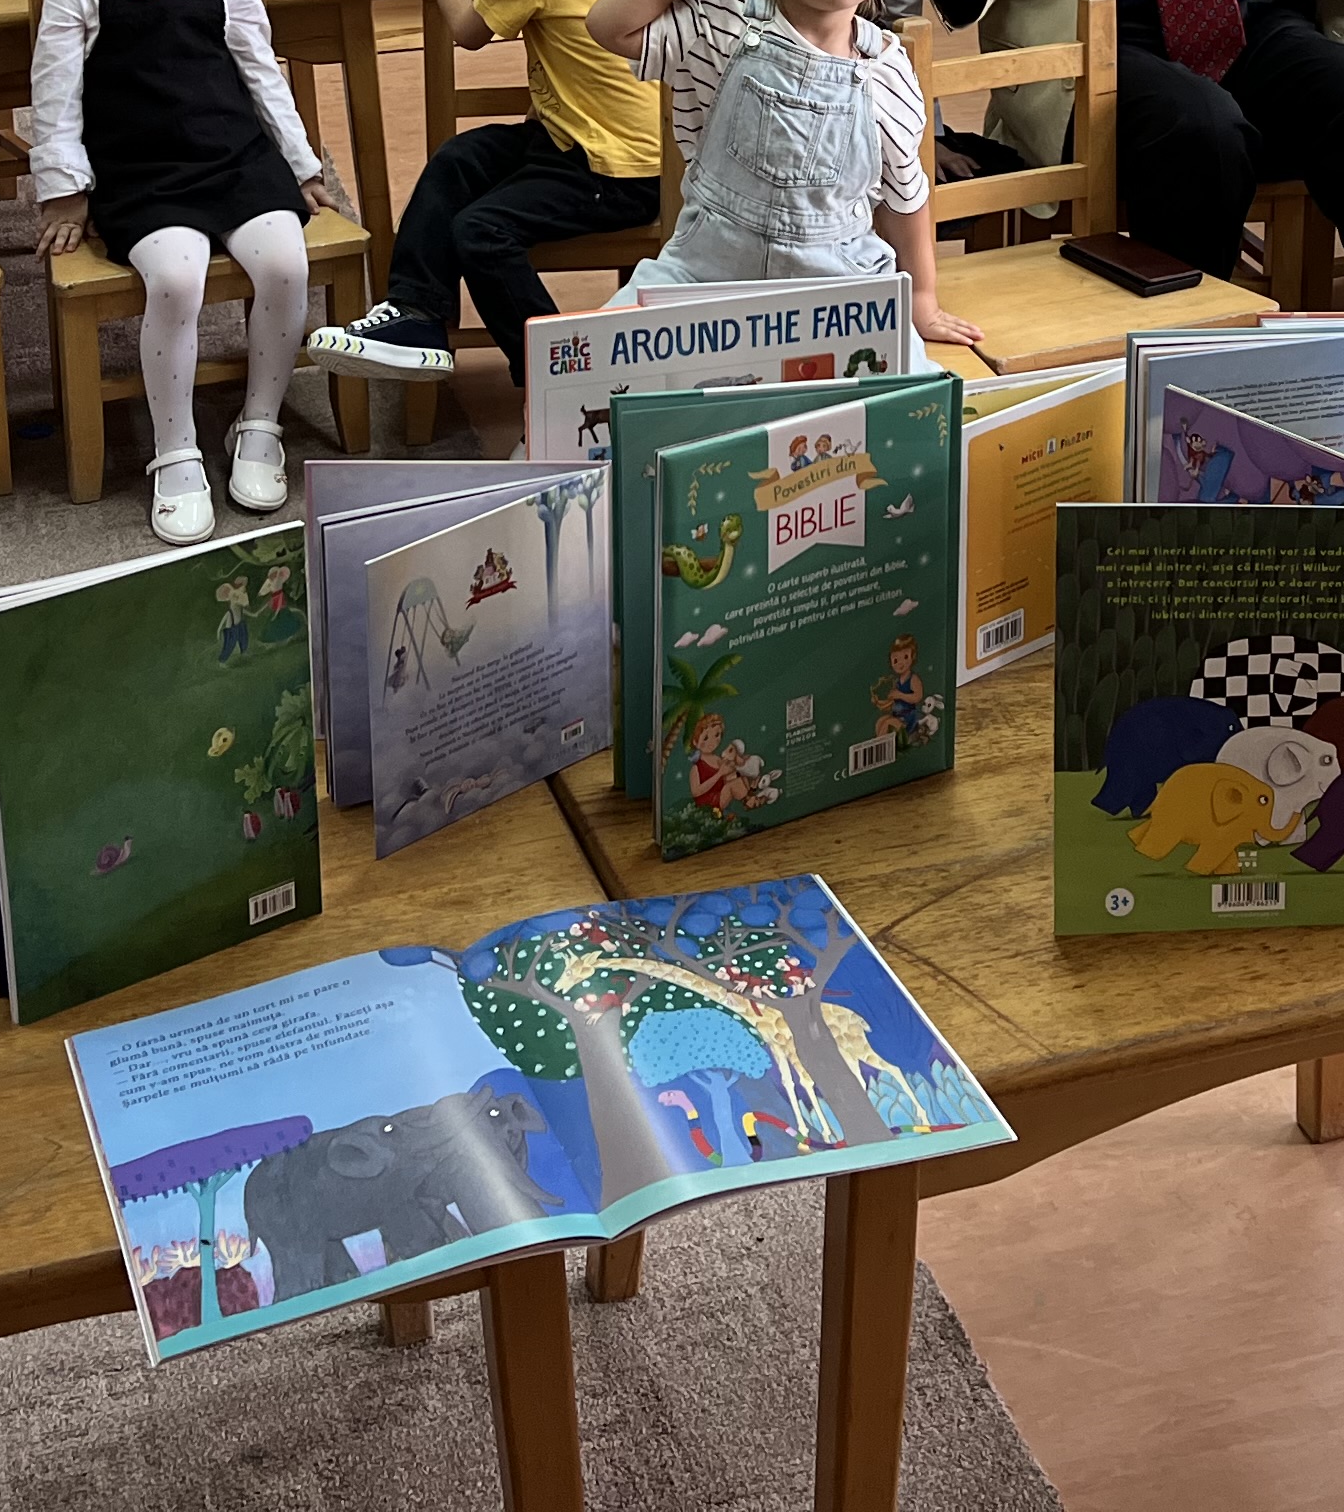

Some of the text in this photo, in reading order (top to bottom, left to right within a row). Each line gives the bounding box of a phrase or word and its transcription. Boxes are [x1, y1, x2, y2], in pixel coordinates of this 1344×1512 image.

[611, 298, 897, 365] AROUND THE FARM
[550, 343, 591, 361] ERIC
[550, 358, 592, 376] CARLE
[773, 457, 857, 503] Povestiri din
[776, 494, 856, 546] BIBLIE
[1106, 547, 1125, 556] Cei
[1128, 547, 1150, 556] mai
[1154, 546, 1186, 556] tineri
[1189, 546, 1226, 556] dintre
[1280, 548, 1299, 557] vor
[777, 577, 800, 592] carte
[802, 567, 829, 584] superb
[1109, 893, 1131, 911] 3+
[135, 1035, 166, 1048] farsă
[169, 1021, 213, 1039] urmată
[216, 1016, 231, 1026] de
[234, 1011, 250, 1020] un
[253, 1002, 277, 1014] tort
[279, 996, 295, 1006] mi
[297, 991, 310, 1000] se
[313, 982, 340, 997] pare
